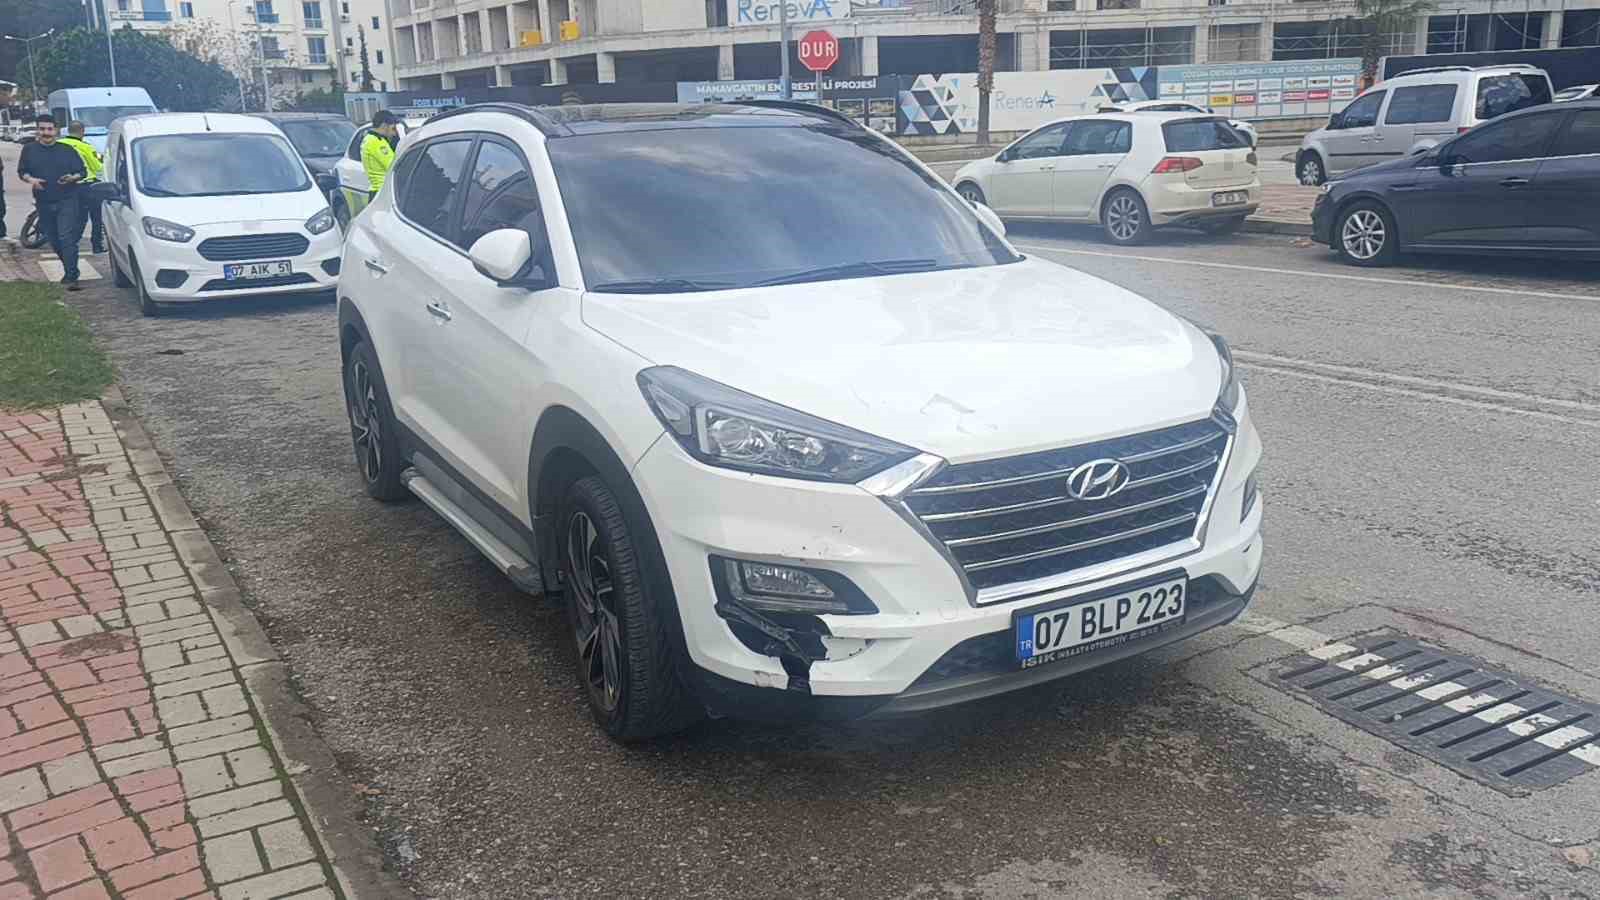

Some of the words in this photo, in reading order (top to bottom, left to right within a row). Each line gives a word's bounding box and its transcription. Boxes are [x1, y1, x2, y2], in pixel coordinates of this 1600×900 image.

[801, 41, 834, 57] DUR
[768, 83, 781, 92] EN
[834, 79, 877, 89] PROJESİ
[251, 263, 270, 275] AIK
[278, 262, 290, 273] 51
[1035, 612, 1069, 650] 07
[1080, 598, 1131, 640] BLP
[1137, 584, 1183, 625] 223
[1021, 639, 1032, 650] TR
